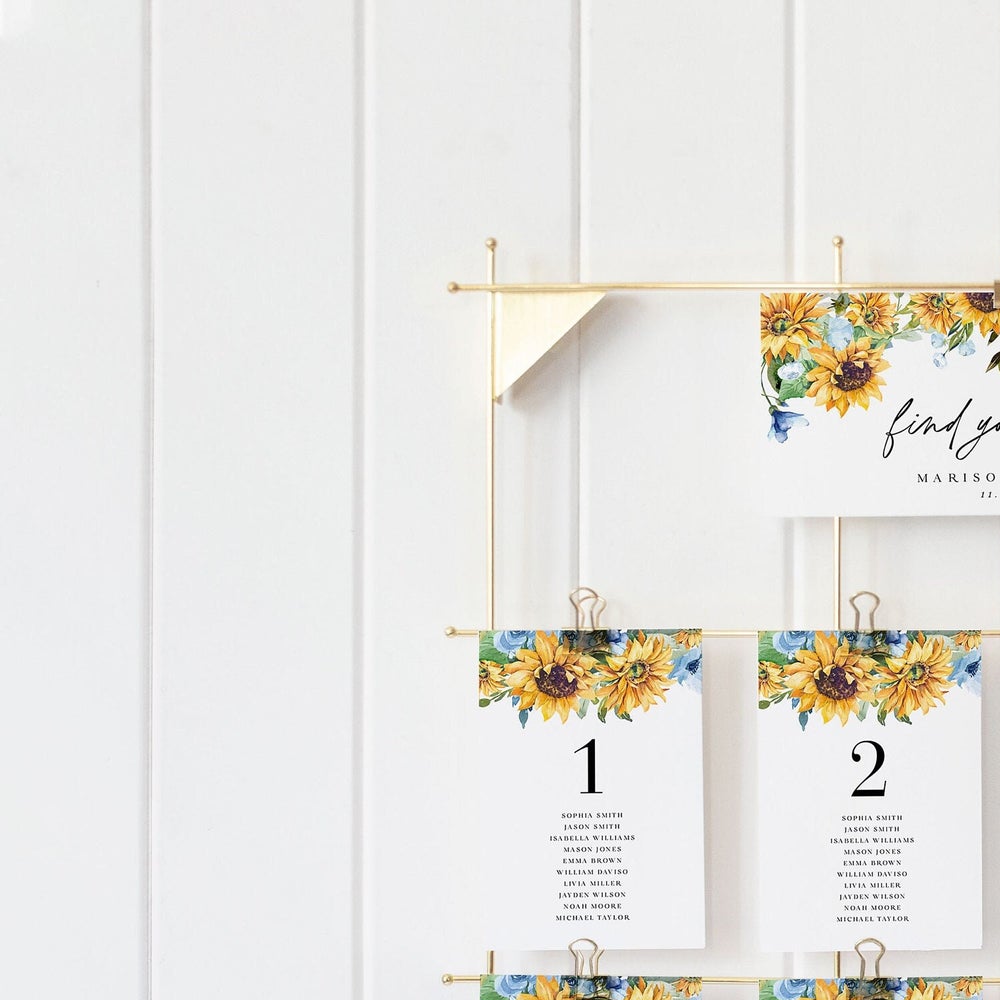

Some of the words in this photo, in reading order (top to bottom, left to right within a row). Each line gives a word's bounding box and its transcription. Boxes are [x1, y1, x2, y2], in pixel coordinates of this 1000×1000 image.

[882, 397, 973, 459] find
[573, 738, 604, 795] 1
[850, 740, 887, 798] 2
[875, 814, 903, 822] SMITH
[564, 823, 590, 831] JASON
[595, 846, 622, 854] JONES
[870, 859, 902, 867] BROWN
[597, 868, 629, 876] DAVISO
[558, 891, 590, 900] JAYDEN
[844, 904, 868, 912] NOAH
[555, 914, 594, 922] MICHAEL
